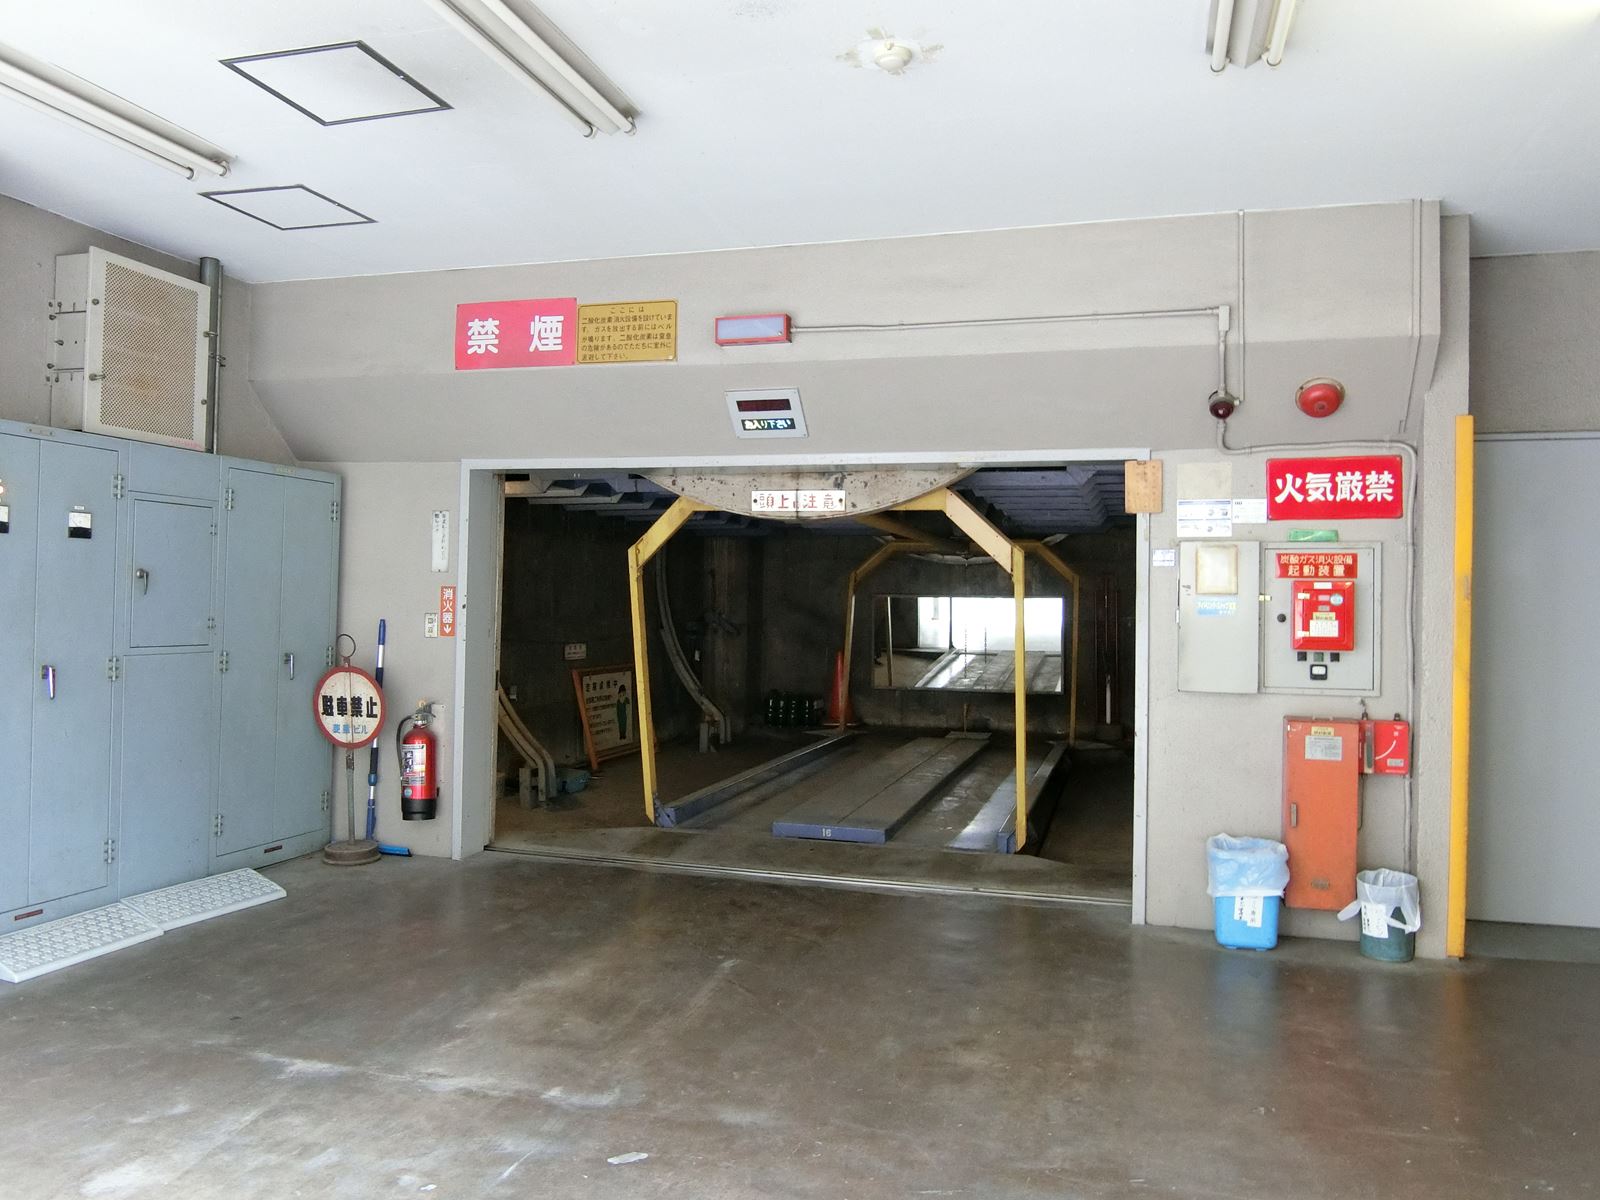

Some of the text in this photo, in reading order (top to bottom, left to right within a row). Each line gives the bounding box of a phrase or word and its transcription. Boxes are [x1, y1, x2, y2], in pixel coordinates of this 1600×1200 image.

[466, 315, 565, 355] 禁煙
[1274, 470, 1395, 504] 火気厳禁
[1280, 554, 1353, 565] 炭酸ガス消火設備
[1288, 564, 1345, 577] 起動装置
[442, 587, 454, 624] 消火器
[321, 694, 378, 719] 駐車禁止
[822, 828, 832, 837] 16
